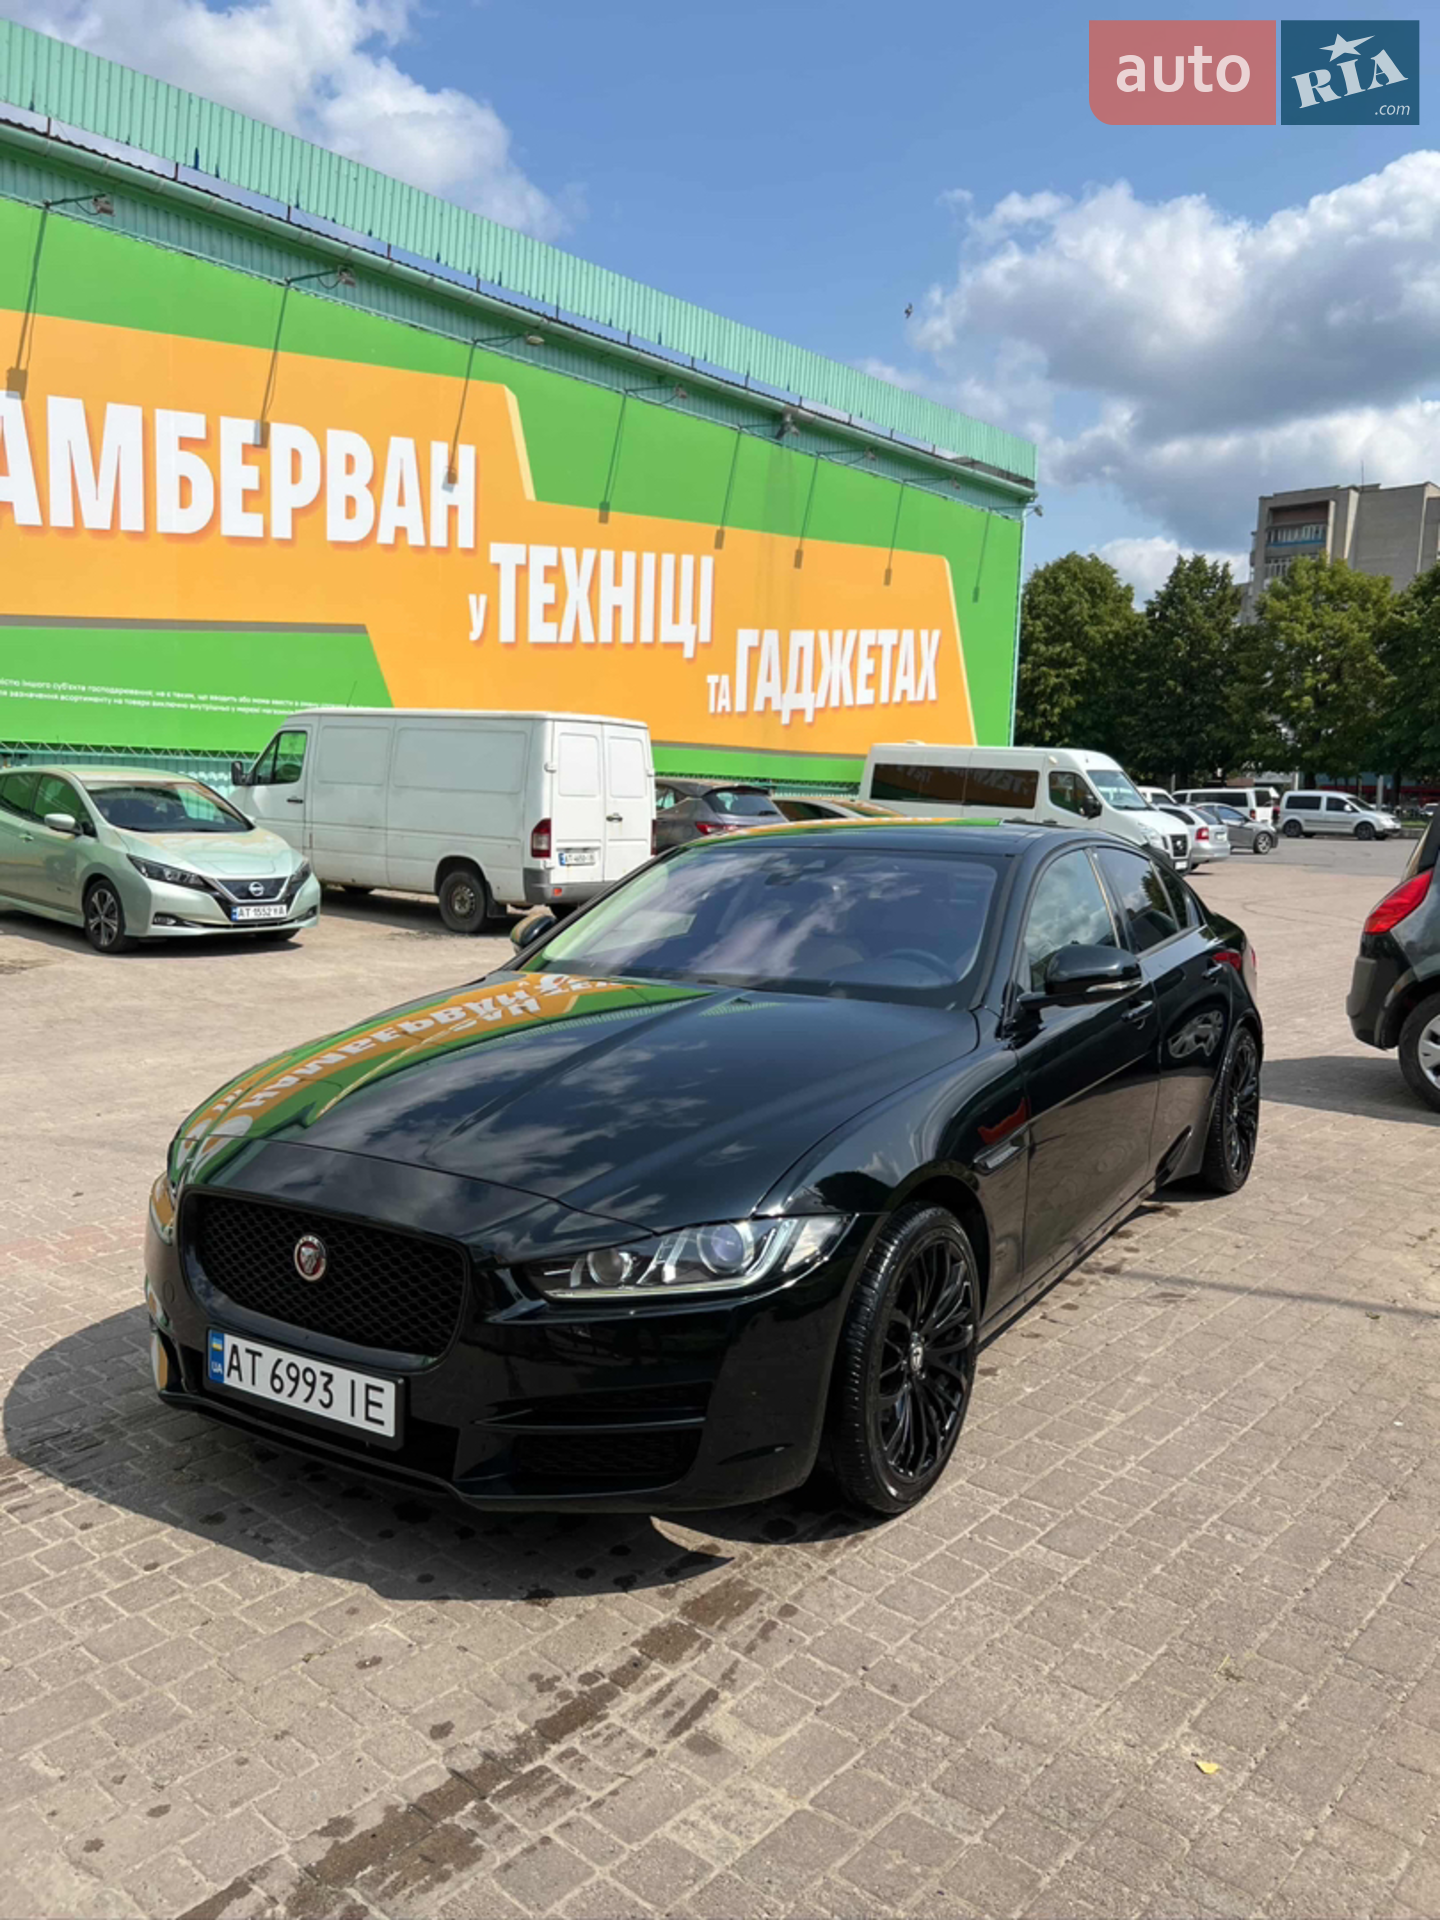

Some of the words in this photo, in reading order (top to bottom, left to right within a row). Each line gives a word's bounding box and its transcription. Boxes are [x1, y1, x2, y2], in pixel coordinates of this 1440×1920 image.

[489, 542, 714, 659] ТЕХНІЦІ
[735, 629, 941, 725] ГАДЖЕТАХ
[226, 1344, 263, 1386] AT
[269, 1358, 334, 1409] 6993
[350, 1379, 385, 1427] IE
